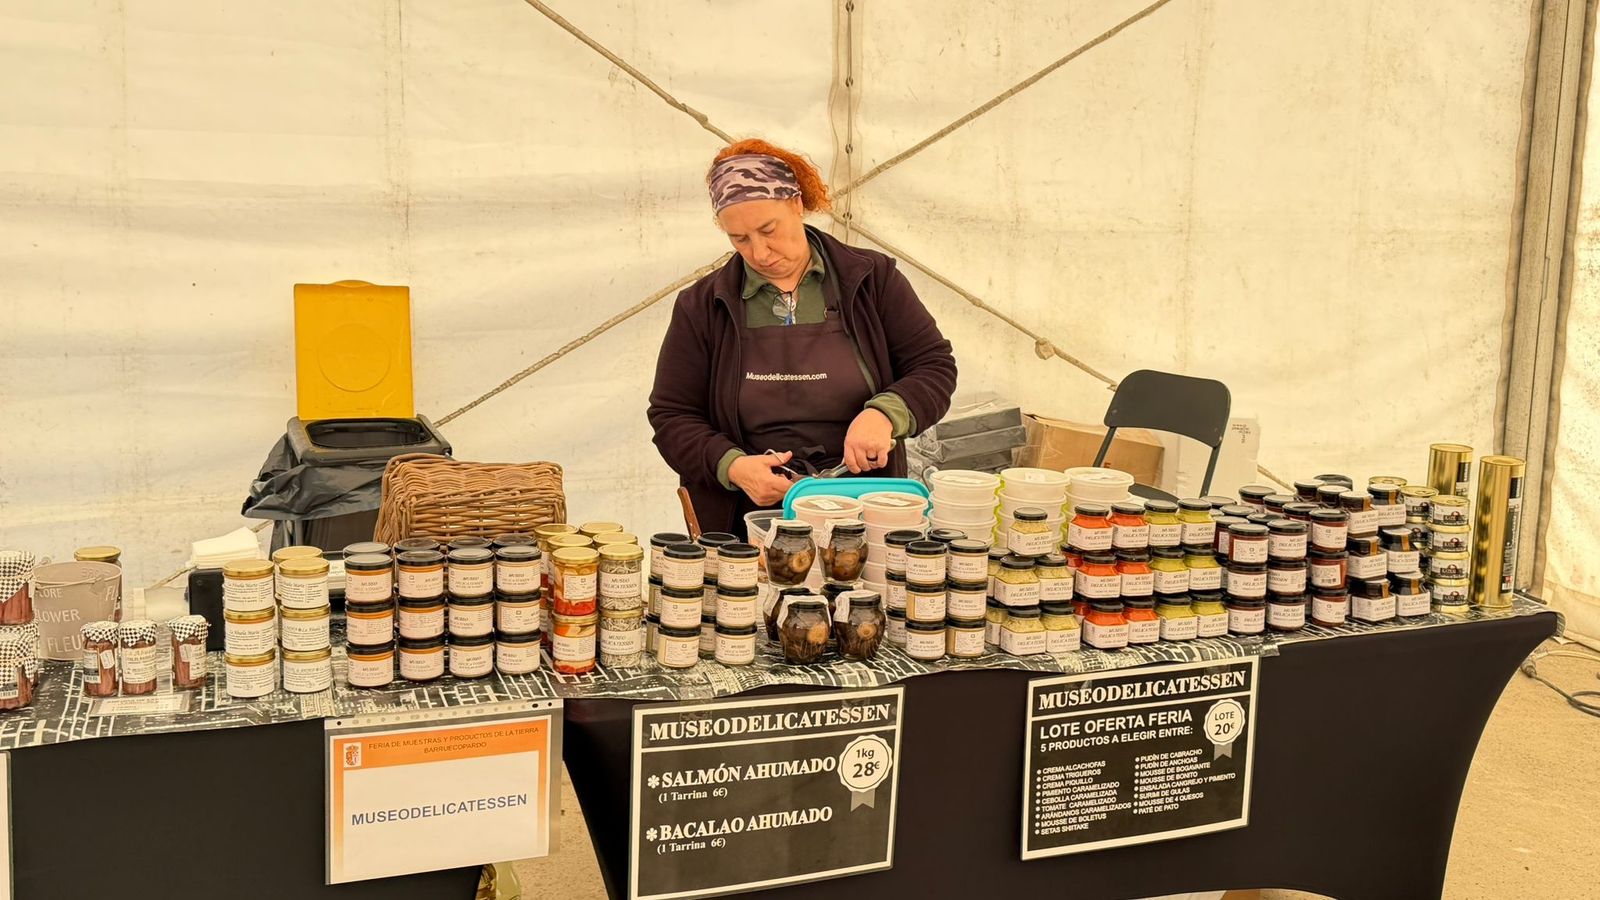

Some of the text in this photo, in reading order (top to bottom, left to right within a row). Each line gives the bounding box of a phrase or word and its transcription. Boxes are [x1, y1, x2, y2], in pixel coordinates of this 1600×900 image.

[746, 372, 827, 381] Museodelicatessen.com
[1038, 670, 1246, 710] MUSEODELICATESSEN
[649, 703, 891, 740] MUSEODELICATESSEN
[1214, 711, 1235, 720] LOTE
[1040, 709, 1192, 739] LOTE OFERTA FERIA
[1214, 722, 1235, 736] 20€
[403, 736, 442, 746] MUESTRAS
[450, 732, 492, 741] PRODUCTOS
[1040, 726, 1193, 752] 5 PRODUCTOS A ELEGIR ENTRE:
[424, 742, 487, 753] BARRUECOPARDO
[856, 748, 875, 760] 1kg
[1140, 753, 1159, 762] PUDÍN
[1170, 749, 1202, 758] CABRACHO
[852, 762, 880, 778] 28€
[1042, 761, 1106, 774] CREMA ALCACHOFAS
[1140, 761, 1159, 770] PUDÍN
[1169, 757, 1198, 766] ANCHOAS
[1140, 768, 1166, 777] MOUSSE
[1176, 762, 1211, 772] BOGAVANTE
[662, 756, 835, 788] SALMÓN AHUMADO
[1042, 768, 1101, 782] CREMA TRIGUEROS
[1140, 776, 1165, 784] MOUSSE
[1176, 771, 1198, 780] BONITO
[1042, 777, 1093, 789] CREMA PIQUILLO
[1042, 782, 1120, 797] PIMIENTO CARAMELIZADO
[1139, 783, 1170, 792] ENSALADA
[1171, 778, 1203, 788] CANGREJO
[1209, 773, 1236, 782] PIMIENTO
[659, 787, 728, 804] (1 Tarrina 6€)
[1042, 789, 1117, 804] CEBOLLA CARAMELIZADA
[1139, 791, 1160, 799] SURIMI
[1170, 787, 1190, 795] GULAS
[1139, 798, 1164, 807] MOUSSE
[1180, 792, 1204, 800] QUESOS
[351, 794, 527, 826] MUSEODELICATESSEN
[1041, 797, 1116, 812] TOMATE CARAMELIZADO
[1041, 802, 1132, 820] ARÁNDANOS CARAMELIZADOS
[1138, 806, 1153, 814] PATÉ
[659, 806, 833, 841] BACALAO AHUMADO
[1041, 818, 1068, 827] MOUSSE
[1078, 813, 1107, 823] BOLETUS
[657, 838, 726, 855] (1 Tarrina 6€)
